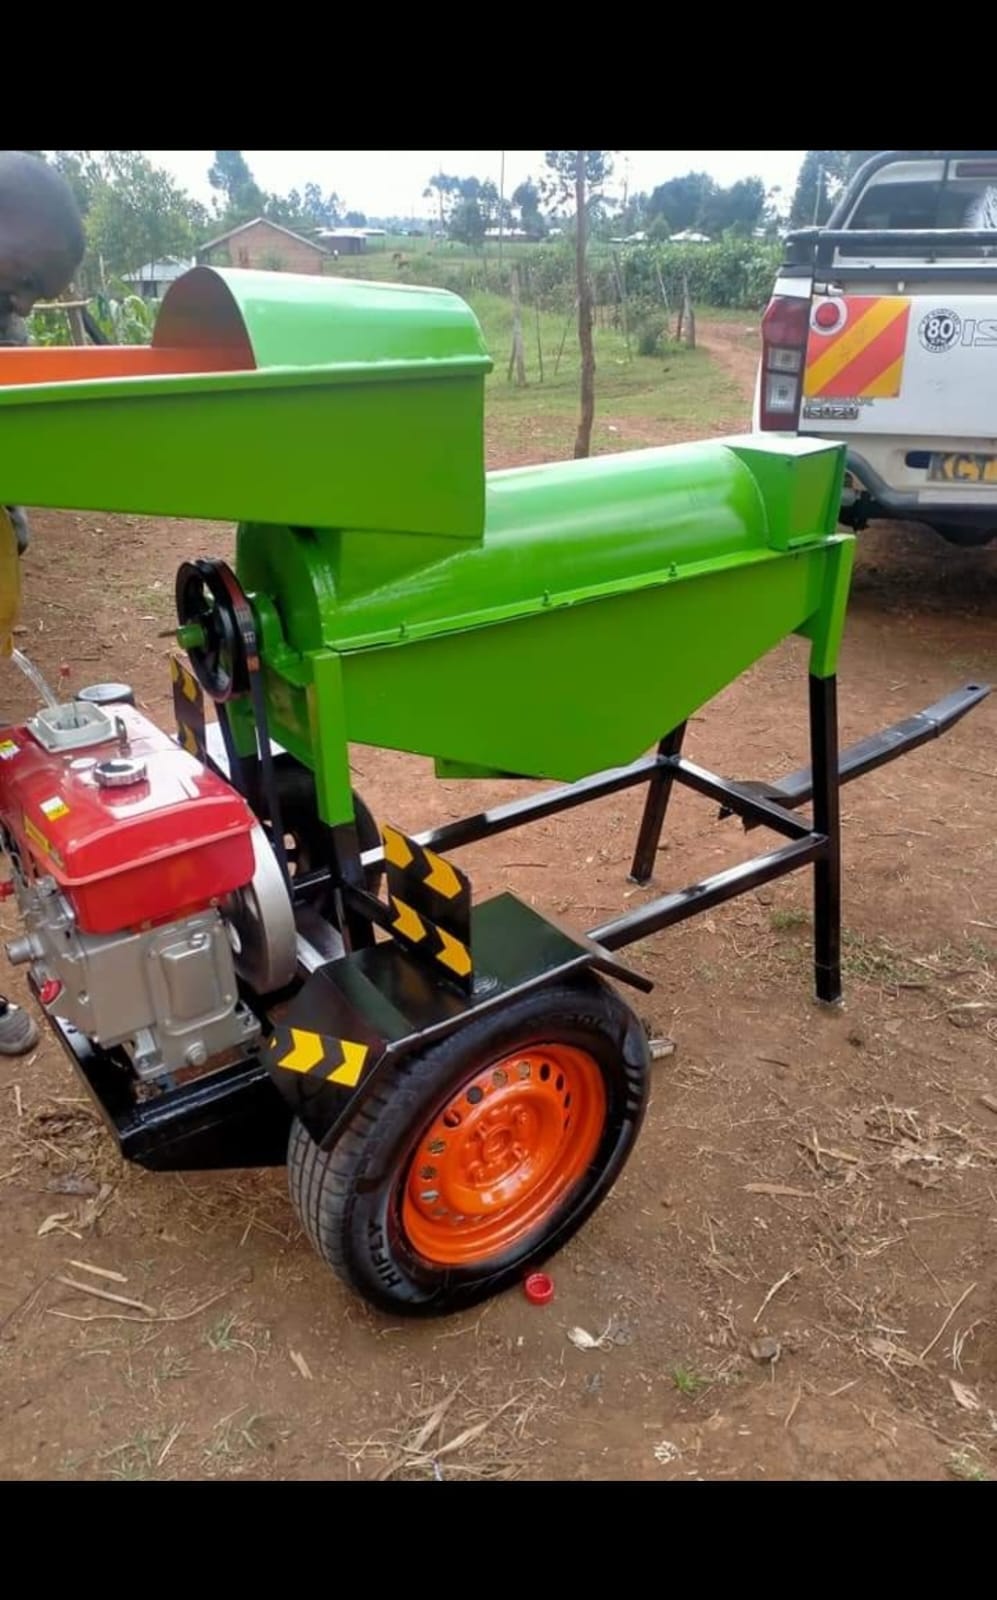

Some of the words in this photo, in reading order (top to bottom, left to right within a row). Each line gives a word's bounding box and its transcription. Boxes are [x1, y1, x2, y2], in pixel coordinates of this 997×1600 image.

[927, 319, 954, 338] 80
[804, 406, 858, 419] ISUZU
[367, 1218, 402, 1289] HIFLY
